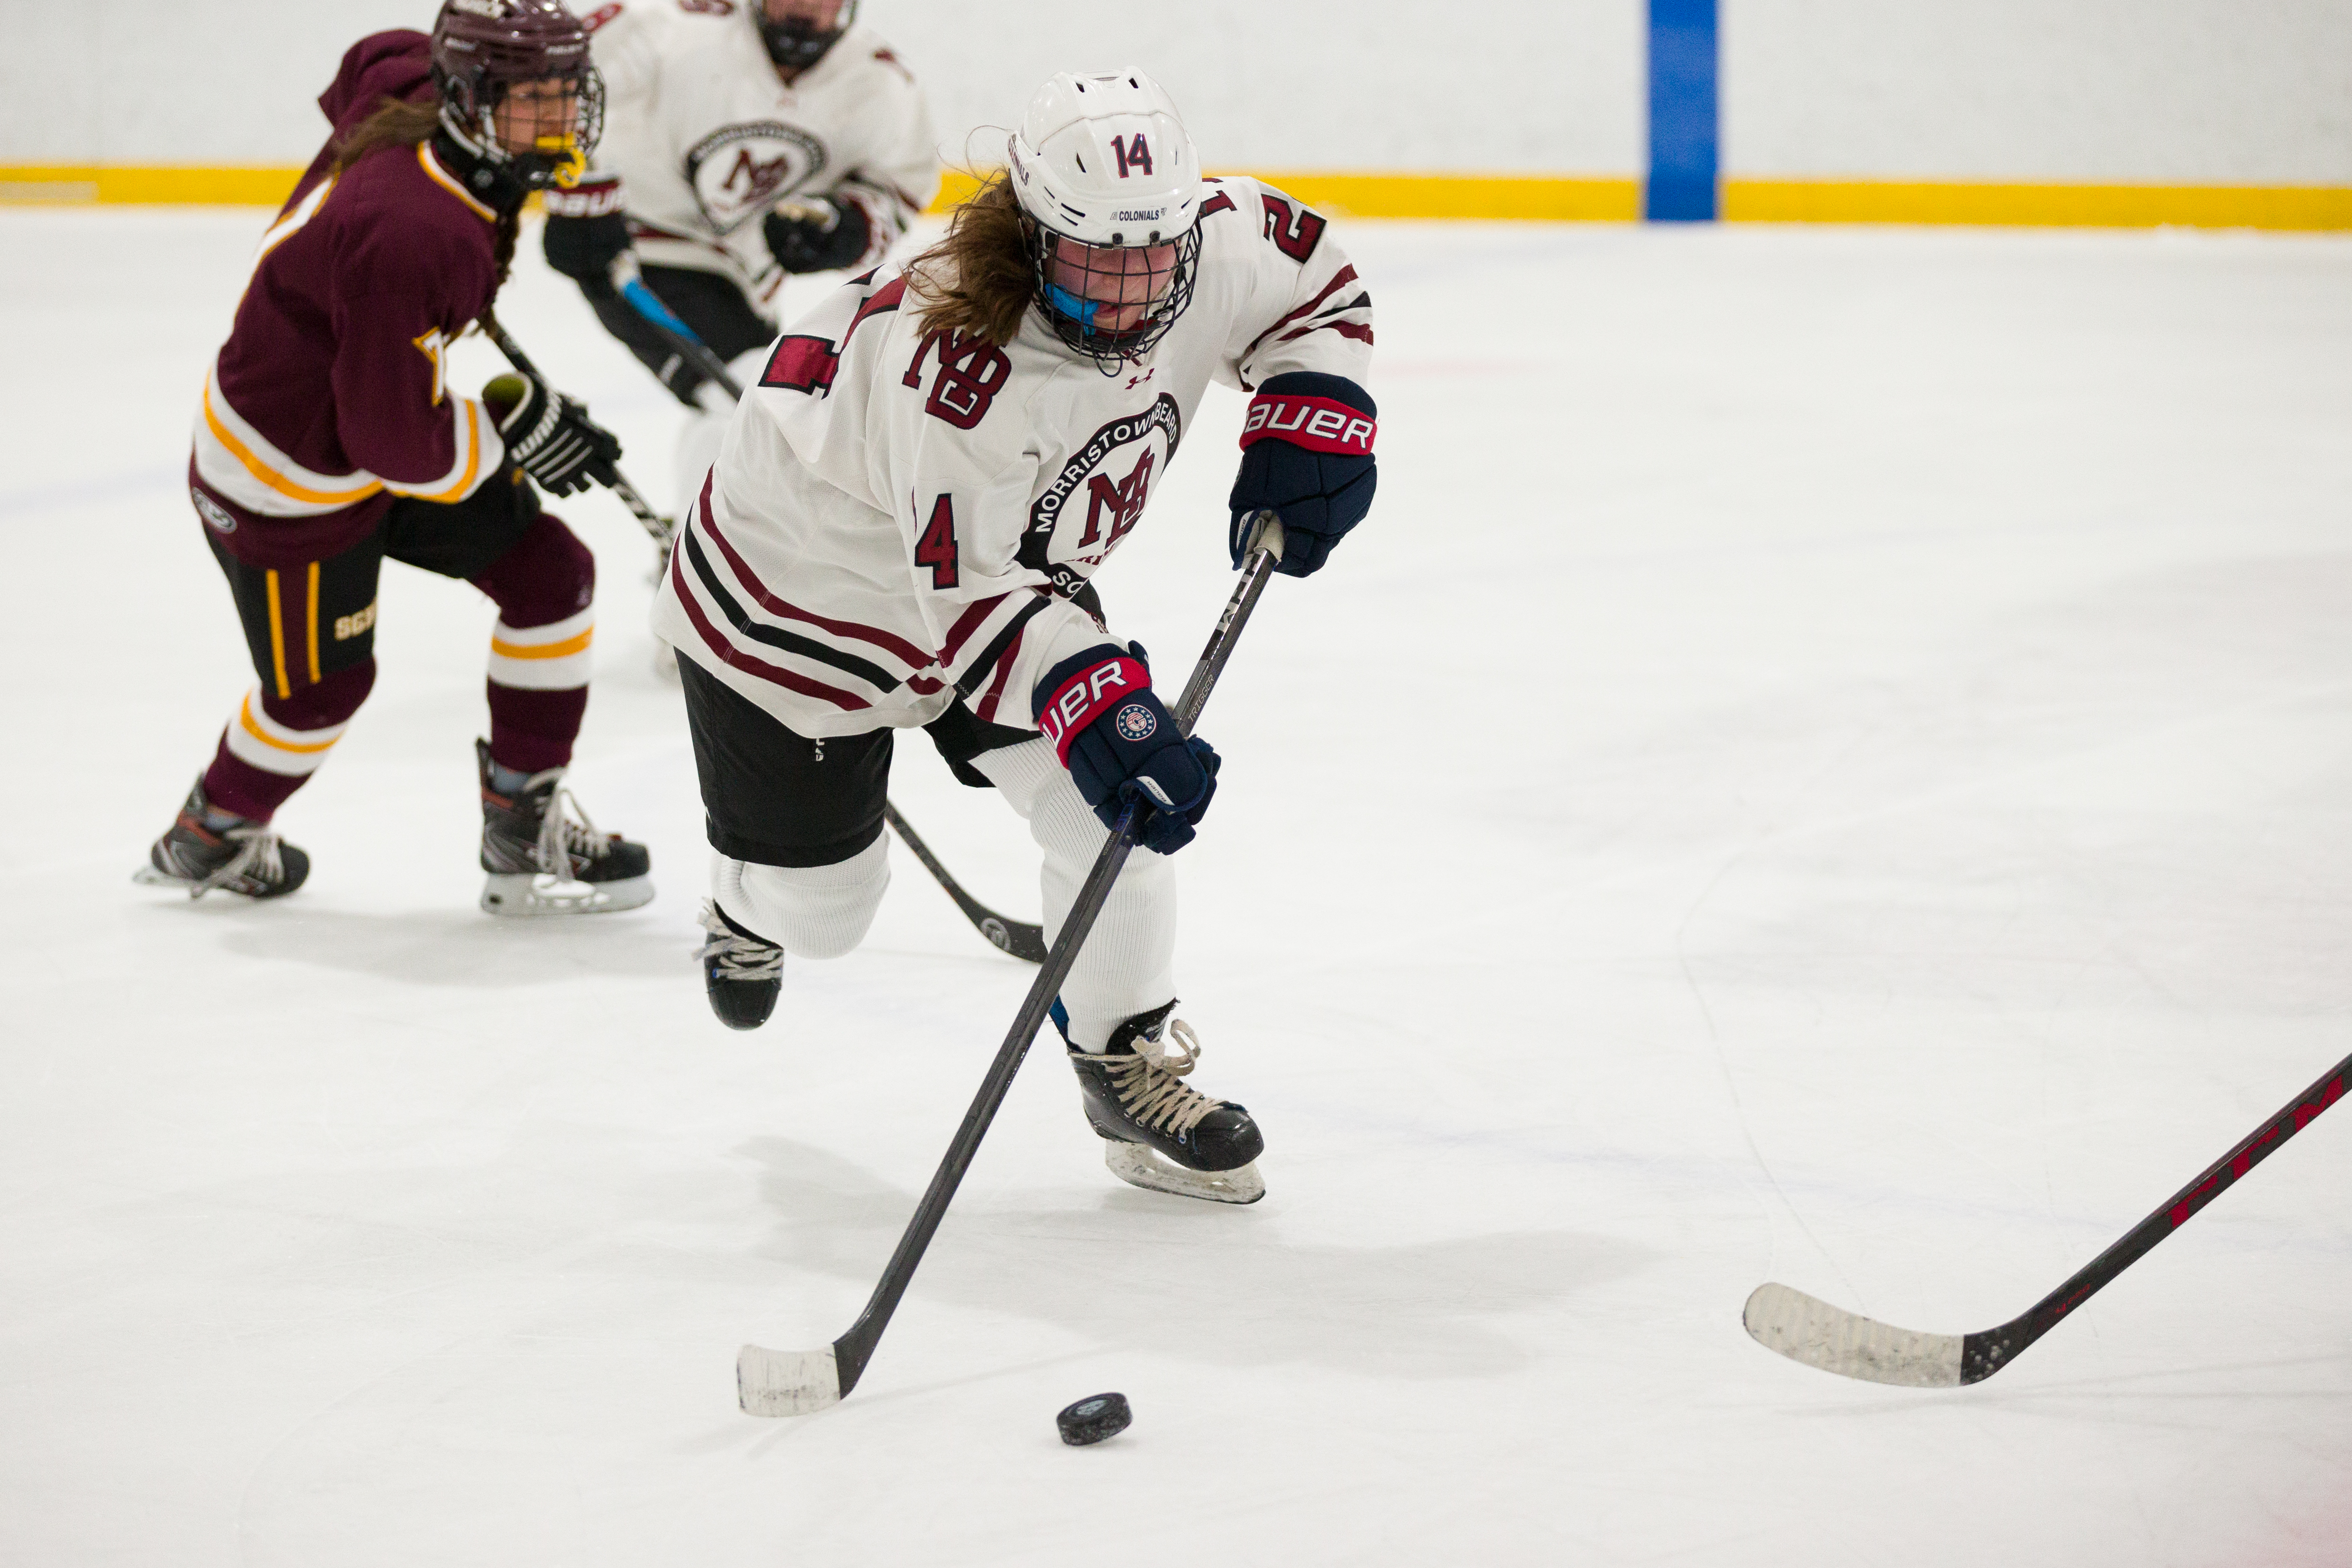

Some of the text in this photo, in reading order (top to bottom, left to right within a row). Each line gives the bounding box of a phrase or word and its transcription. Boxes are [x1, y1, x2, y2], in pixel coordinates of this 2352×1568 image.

[1110, 132, 1153, 178] 14
[1119, 210, 1159, 221] COLONIALS
[1244, 403, 1374, 449] AUER
[914, 493, 960, 590] 4
[1187, 673, 1215, 722] TRIGGER
